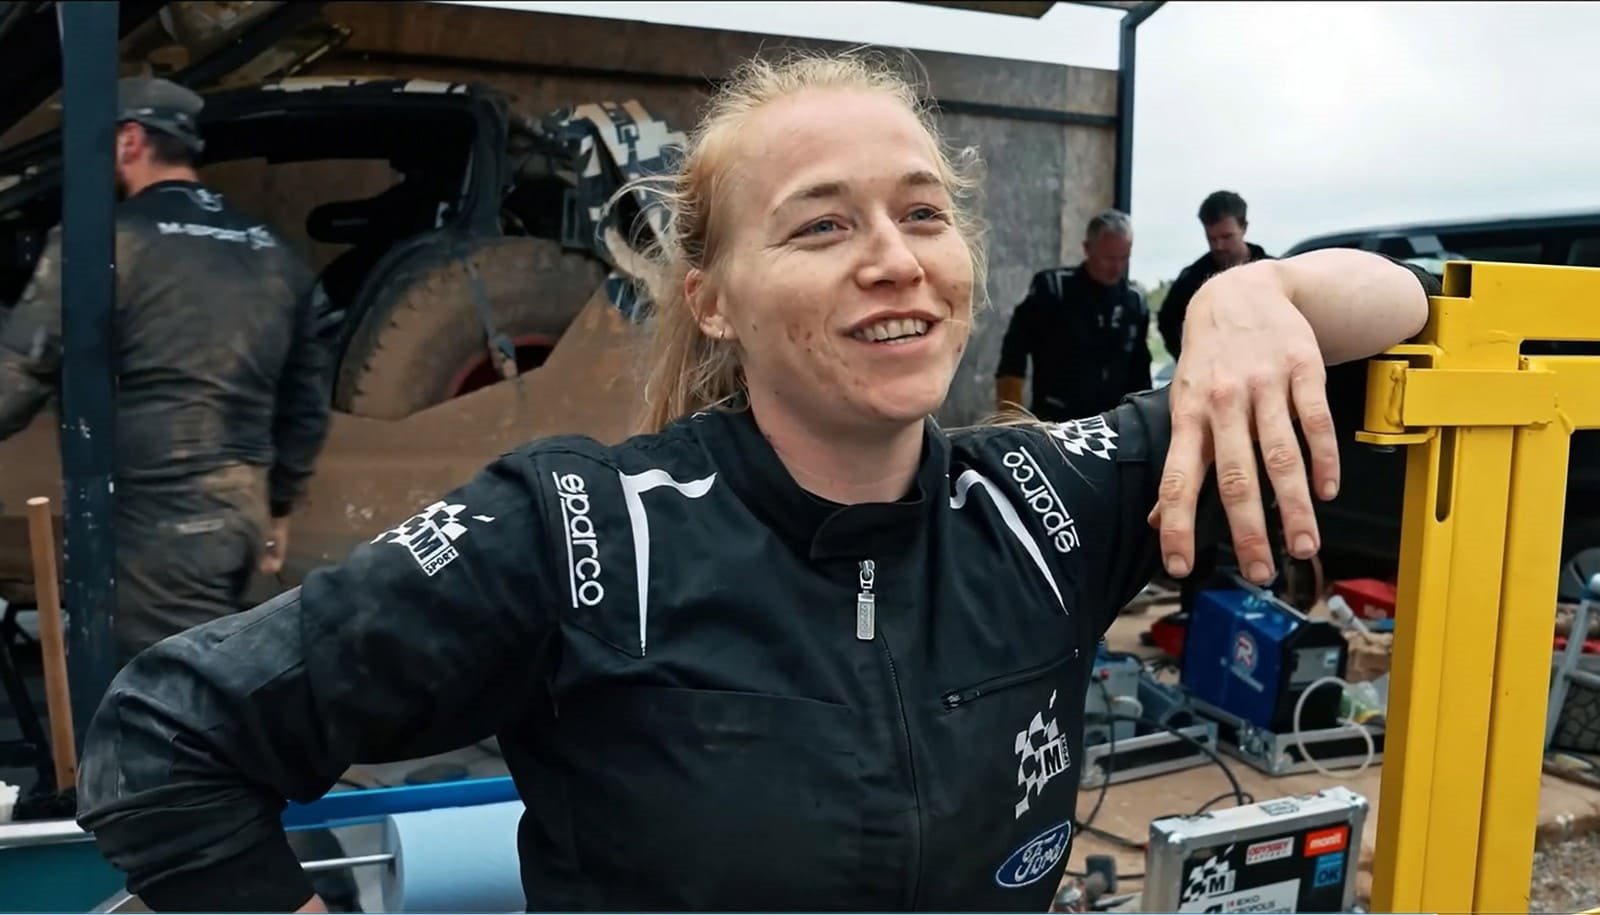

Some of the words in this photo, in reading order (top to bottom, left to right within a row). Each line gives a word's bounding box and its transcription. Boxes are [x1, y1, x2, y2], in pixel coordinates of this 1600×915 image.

[408, 527, 444, 560] M
[424, 548, 456, 574] SPORT
[1043, 743, 1063, 777] M
[1014, 832, 1064, 882] Ford
[1208, 875, 1227, 893] M
[1316, 869, 1340, 886] OK
